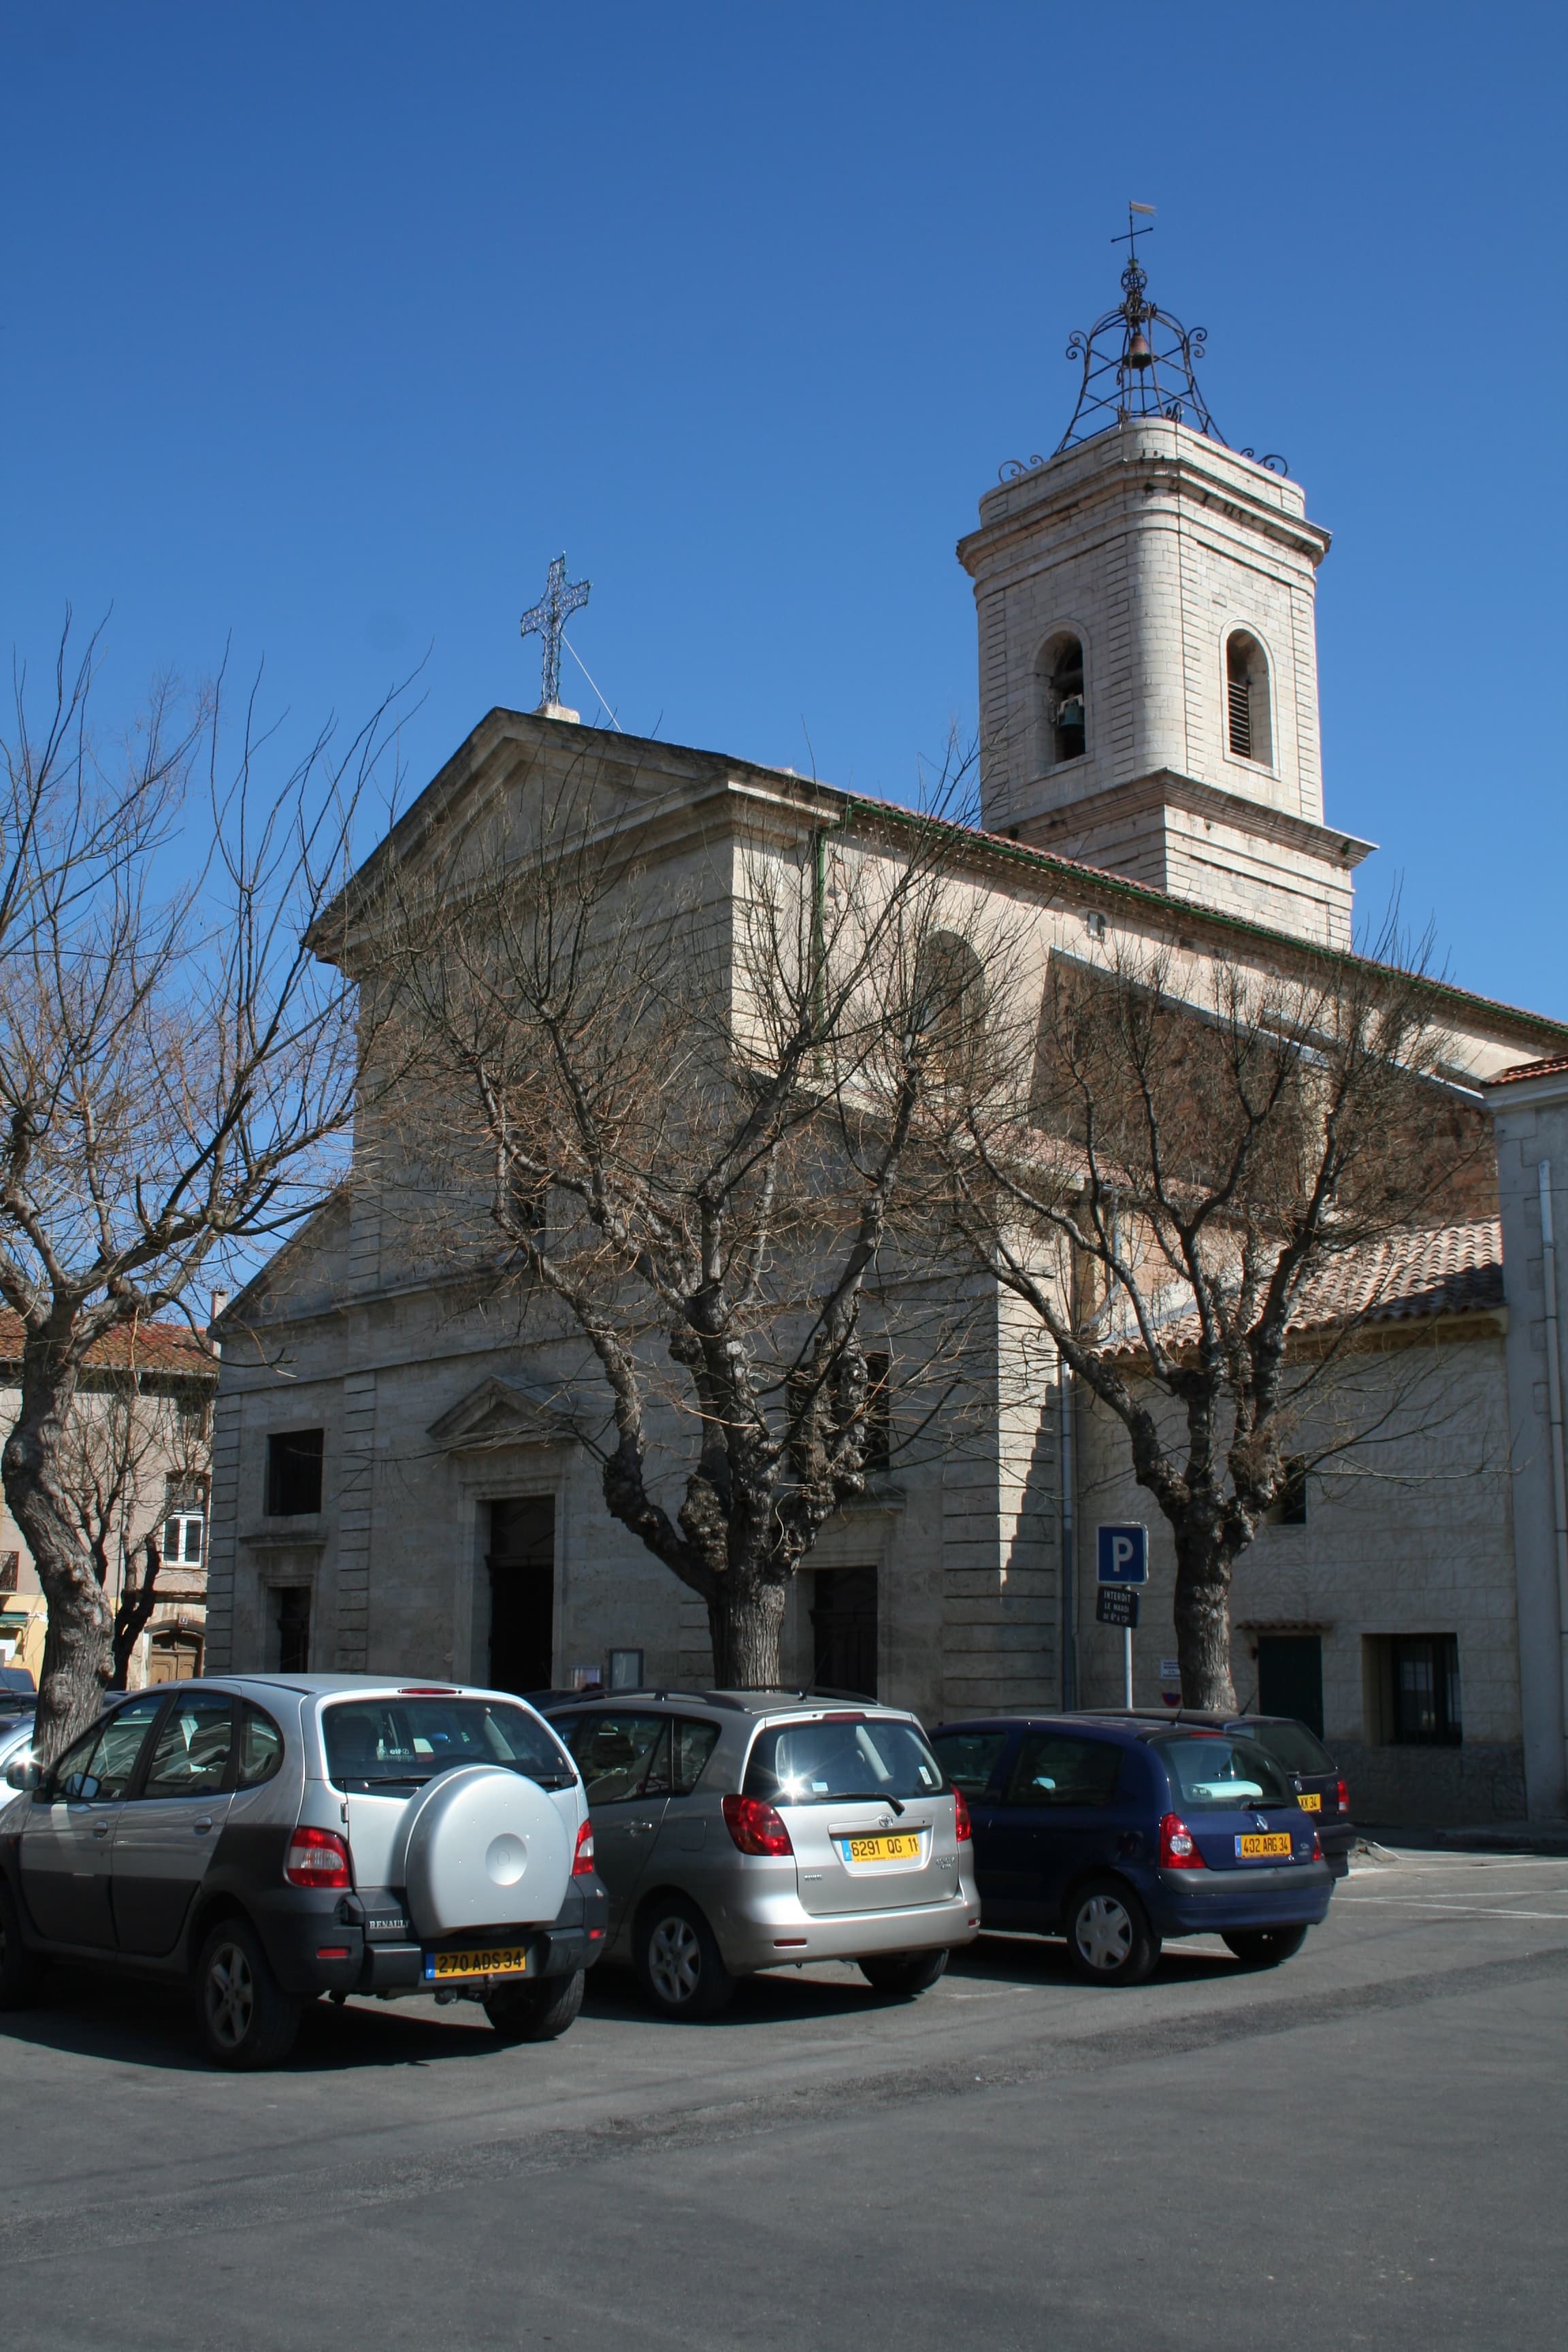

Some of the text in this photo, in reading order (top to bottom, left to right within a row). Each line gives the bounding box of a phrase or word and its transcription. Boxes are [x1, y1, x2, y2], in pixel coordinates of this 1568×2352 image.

[1112, 1535, 1133, 1572] P
[1103, 1589, 1131, 1603] INTERDIT
[1113, 1603, 1130, 1613] MARDI
[1309, 1796, 1317, 1808] 34
[851, 1837, 918, 1857] 6291 QG 11
[1263, 1838, 1277, 1852] ARG
[1279, 1836, 1288, 1851] 34
[370, 1920, 409, 1929] RENAULT
[439, 1950, 521, 1973] 270 ADS 34
